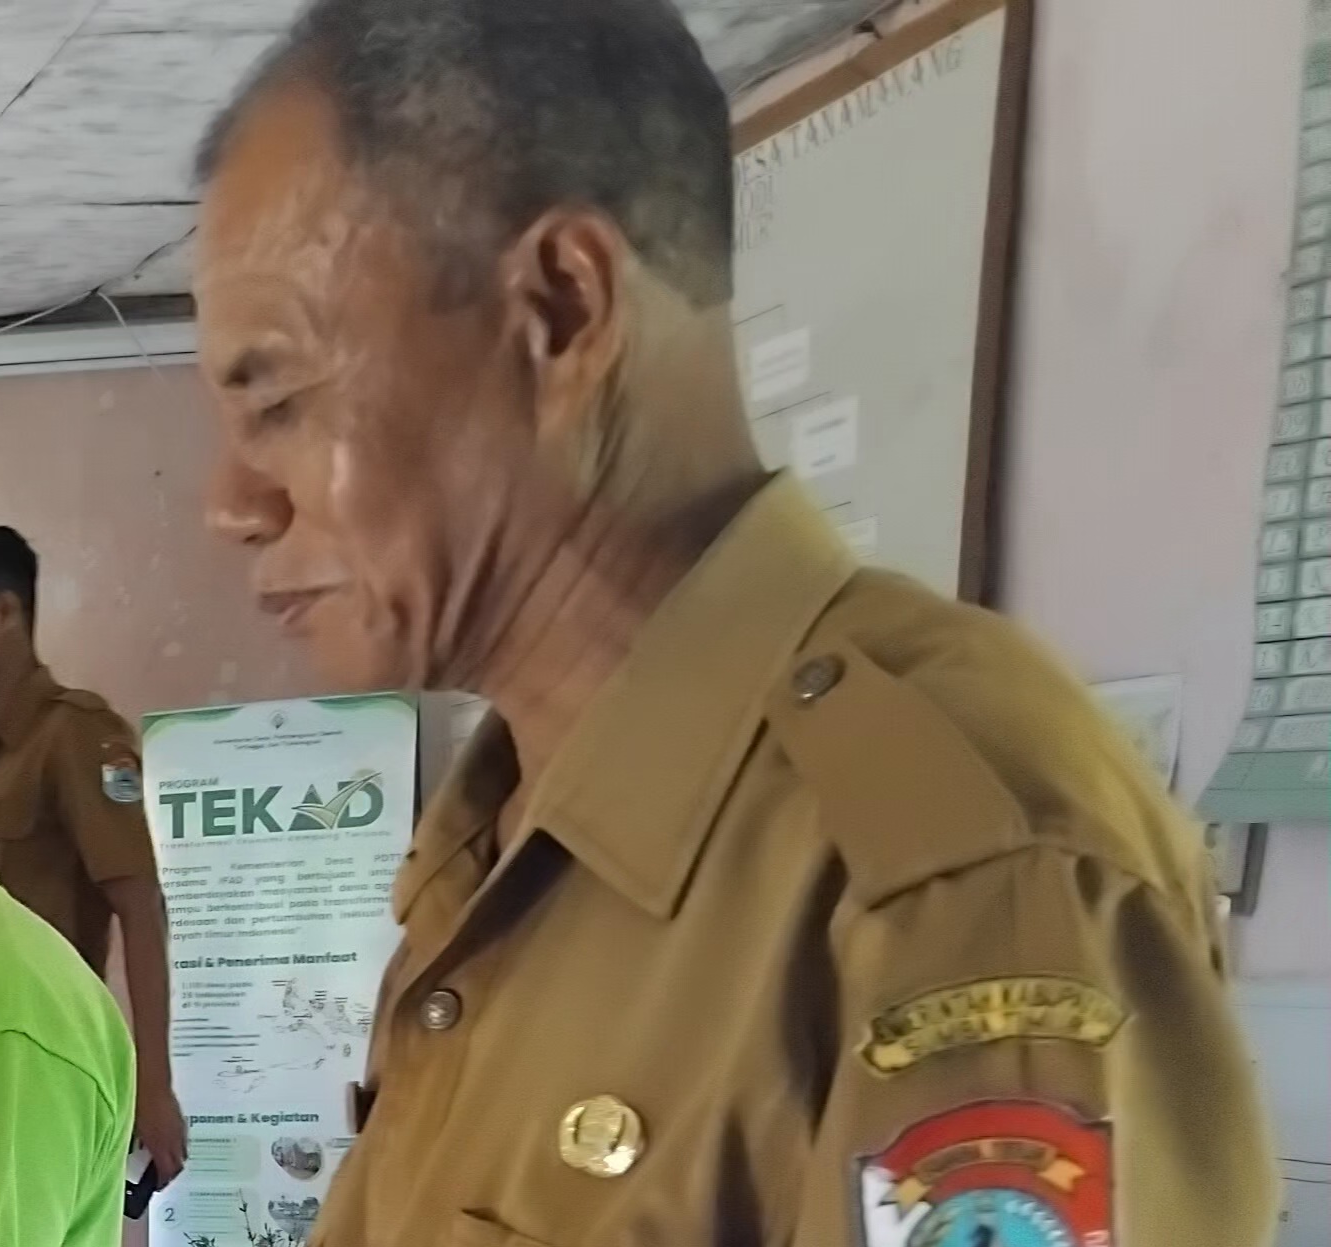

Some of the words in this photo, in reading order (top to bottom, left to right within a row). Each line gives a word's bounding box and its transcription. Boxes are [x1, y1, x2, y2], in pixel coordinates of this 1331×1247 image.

[159, 777, 219, 790] PROGRAM
[158, 780, 385, 839] TEKAD
[205, 956, 215, 968] &
[217, 954, 290, 967] Penerima
[293, 951, 357, 965] Manfaat
[186, 1113, 235, 1127] ponen
[236, 1112, 247, 1123] &
[251, 1111, 319, 1126] Kegiatan
[164, 1207, 176, 1222] 2
